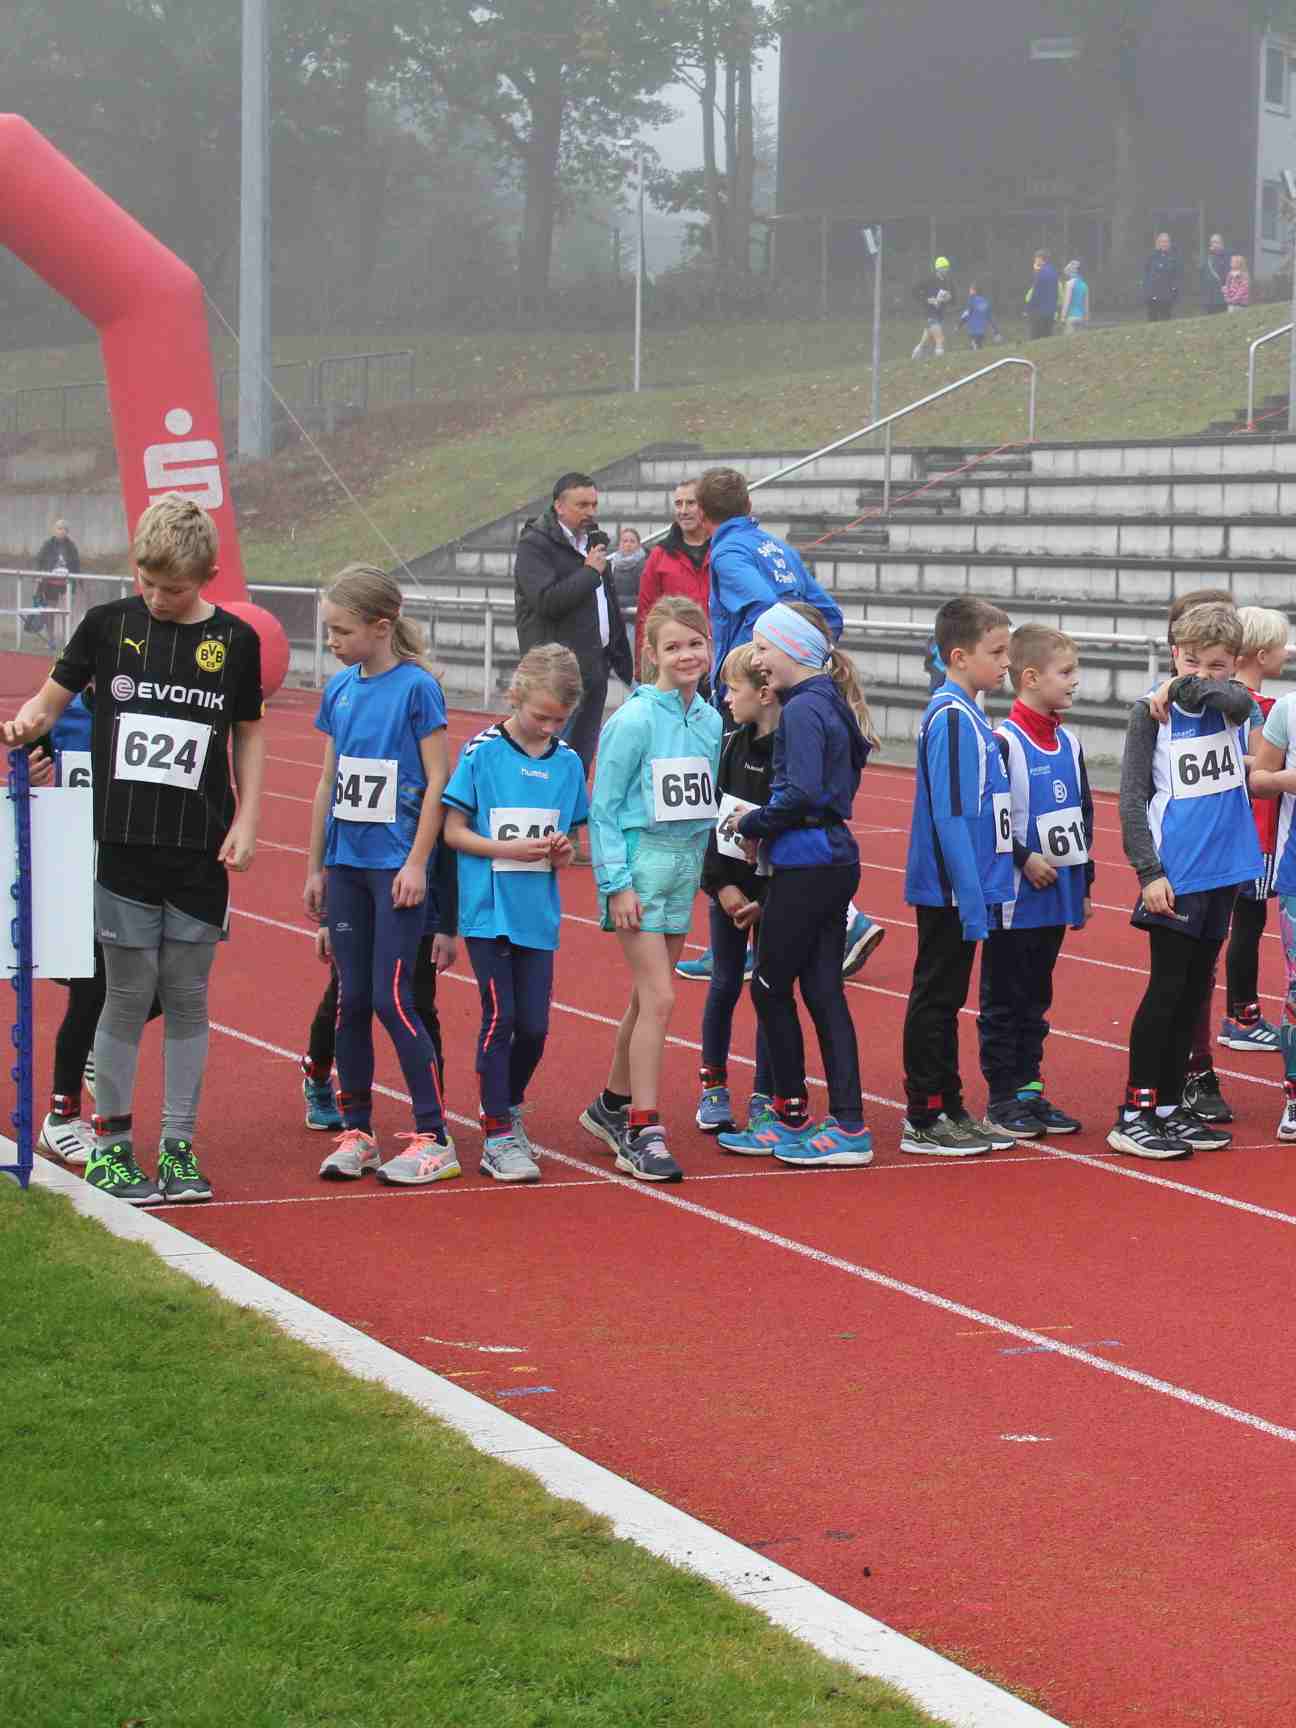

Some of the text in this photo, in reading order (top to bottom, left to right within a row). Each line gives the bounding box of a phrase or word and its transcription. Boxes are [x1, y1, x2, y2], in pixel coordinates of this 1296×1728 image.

[199, 643, 224, 663] BVB
[137, 681, 225, 711] EVONIK
[124, 730, 198, 774] 624
[1178, 745, 1235, 786] 644
[336, 771, 388, 808] 647
[662, 772, 712, 807] 650
